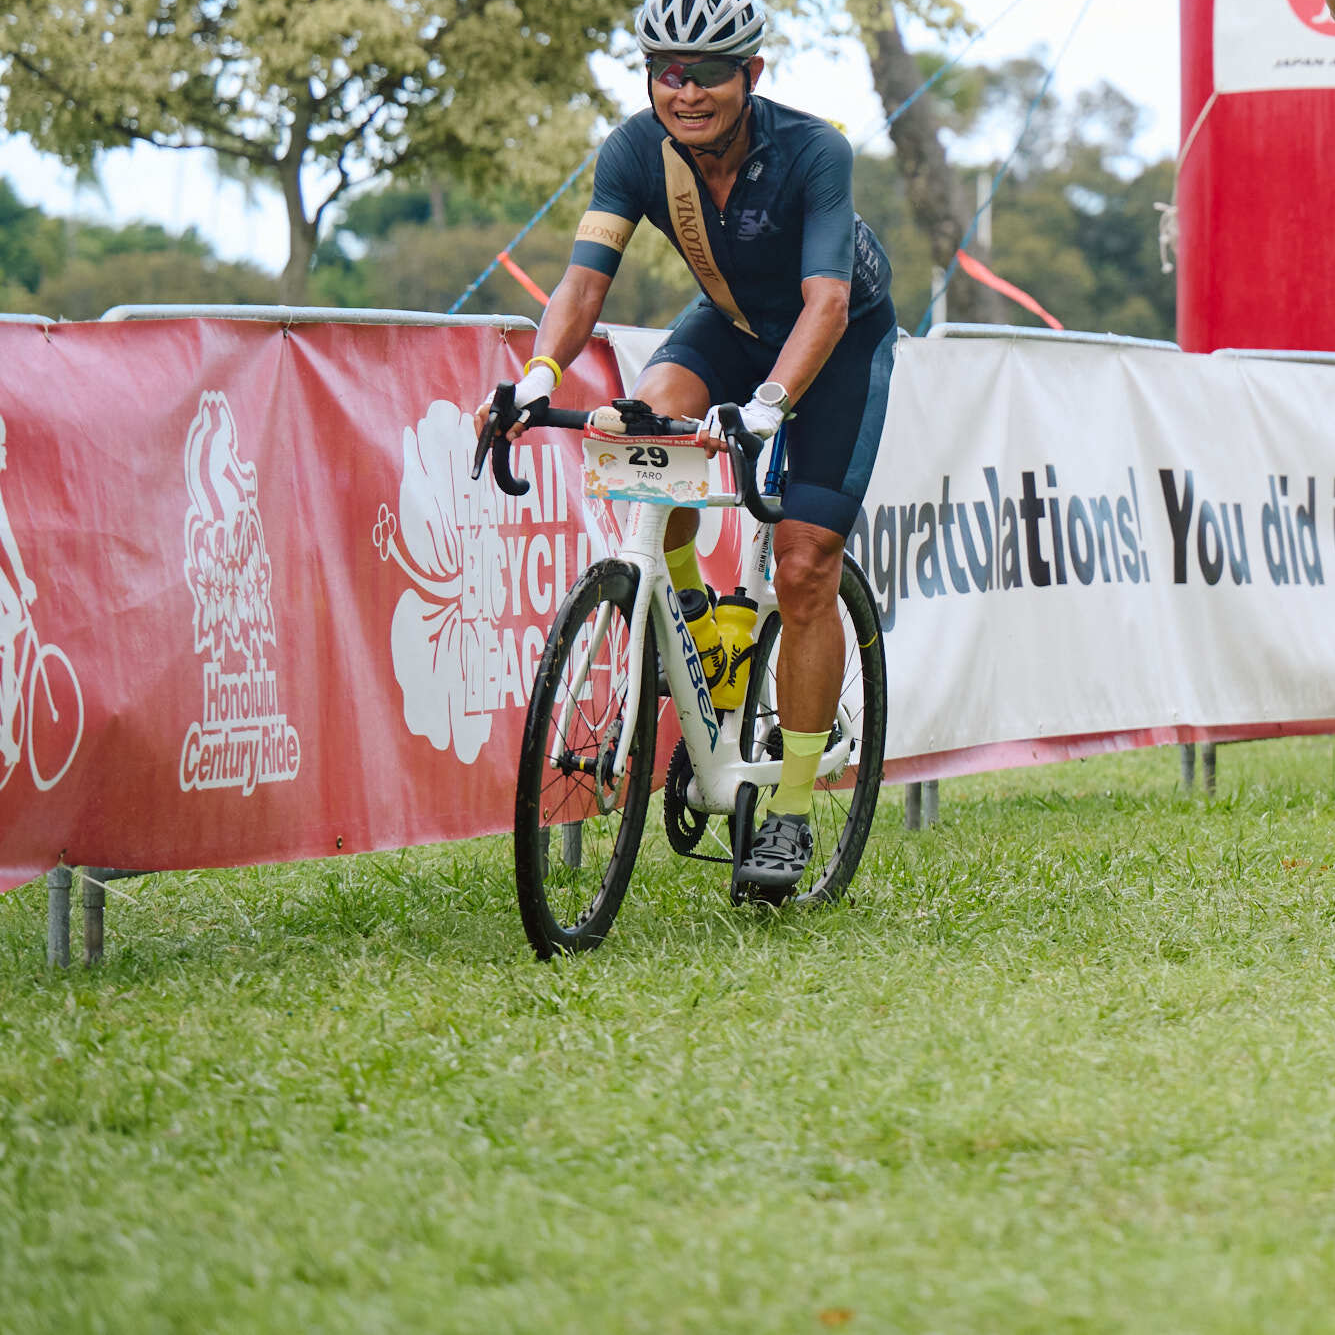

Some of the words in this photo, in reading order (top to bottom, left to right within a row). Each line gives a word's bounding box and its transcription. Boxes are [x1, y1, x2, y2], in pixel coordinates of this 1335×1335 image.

[625, 445, 669, 468] 29
[635, 470, 663, 481] TARO
[843, 464, 1152, 633] ngratulations!
[1157, 467, 1253, 586] You
[1262, 473, 1326, 587] did
[205, 666, 278, 723] Honolulu
[666, 583, 720, 755] ORBEA
[182, 730, 260, 789] Century
[261, 721, 299, 776] Ride
